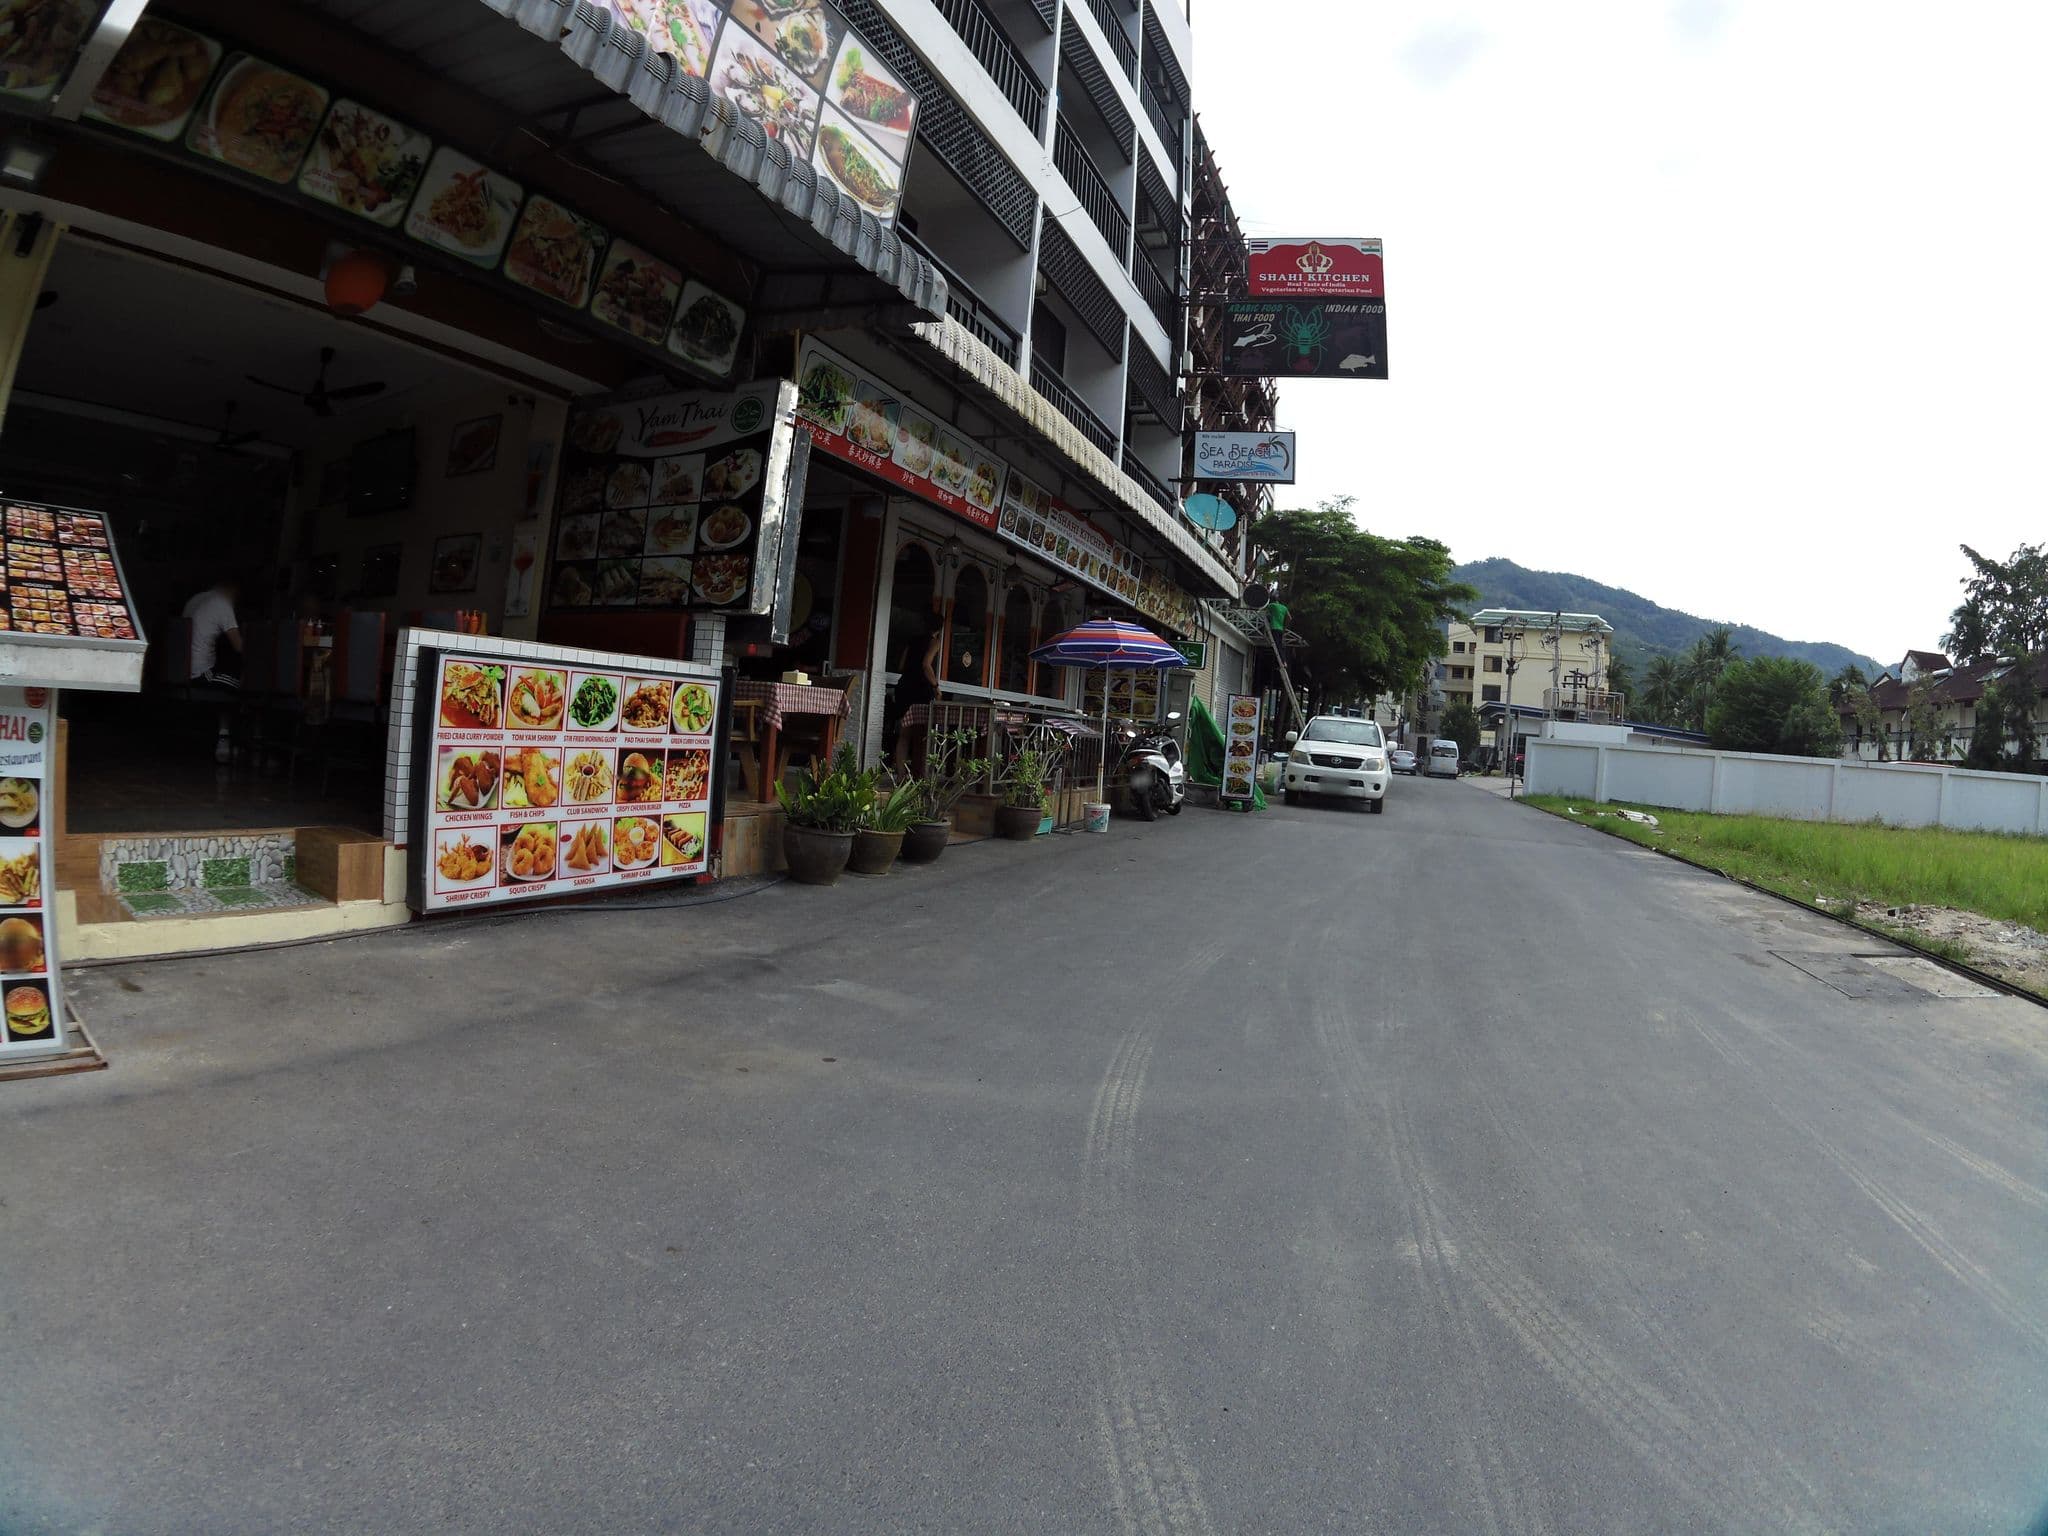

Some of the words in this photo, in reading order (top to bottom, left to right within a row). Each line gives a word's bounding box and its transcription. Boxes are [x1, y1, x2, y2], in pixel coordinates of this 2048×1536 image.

[1259, 273, 1302, 282] SHAHI
[1308, 273, 1369, 282] KITCHEN
[1228, 304, 1260, 313] ARABIC
[1262, 304, 1284, 313] FOOD
[1325, 304, 1359, 313] INDIAN
[1360, 305, 1384, 314] FOOD
[1233, 313, 1252, 322] THAI
[1253, 313, 1275, 322] FOOD
[631, 405, 681, 443] Yam
[682, 399, 728, 428] Thai
[1213, 460, 1255, 468] PARADISE
[1057, 512, 1080, 537] SHAHI
[1079, 527, 1107, 553] KITCHEN
[0, 714, 26, 741] HAI
[437, 732, 451, 741] FRIED
[452, 733, 465, 741] CRAB
[466, 733, 481, 742] CURRY
[482, 733, 504, 742] POWDER
[512, 734, 524, 742] TOM
[525, 734, 536, 742] YAM
[573, 735, 584, 743] FRIED
[0, 752, 42, 765] staurant
[510, 811, 522, 819] FISH
[529, 810, 545, 818] CHIPS
[581, 806, 608, 815] SANDWICH
[445, 814, 471, 823] CHICKEN
[472, 812, 493, 821] WINGS
[621, 872, 638, 880] SHRIMP
[639, 870, 651, 878] CAKE
[574, 877, 595, 886] SAMOSA
[509, 886, 527, 895] SQUID
[528, 884, 546, 892] CRISPY
[446, 893, 469, 902] SHRIMP
[470, 890, 491, 900] CRISPY
